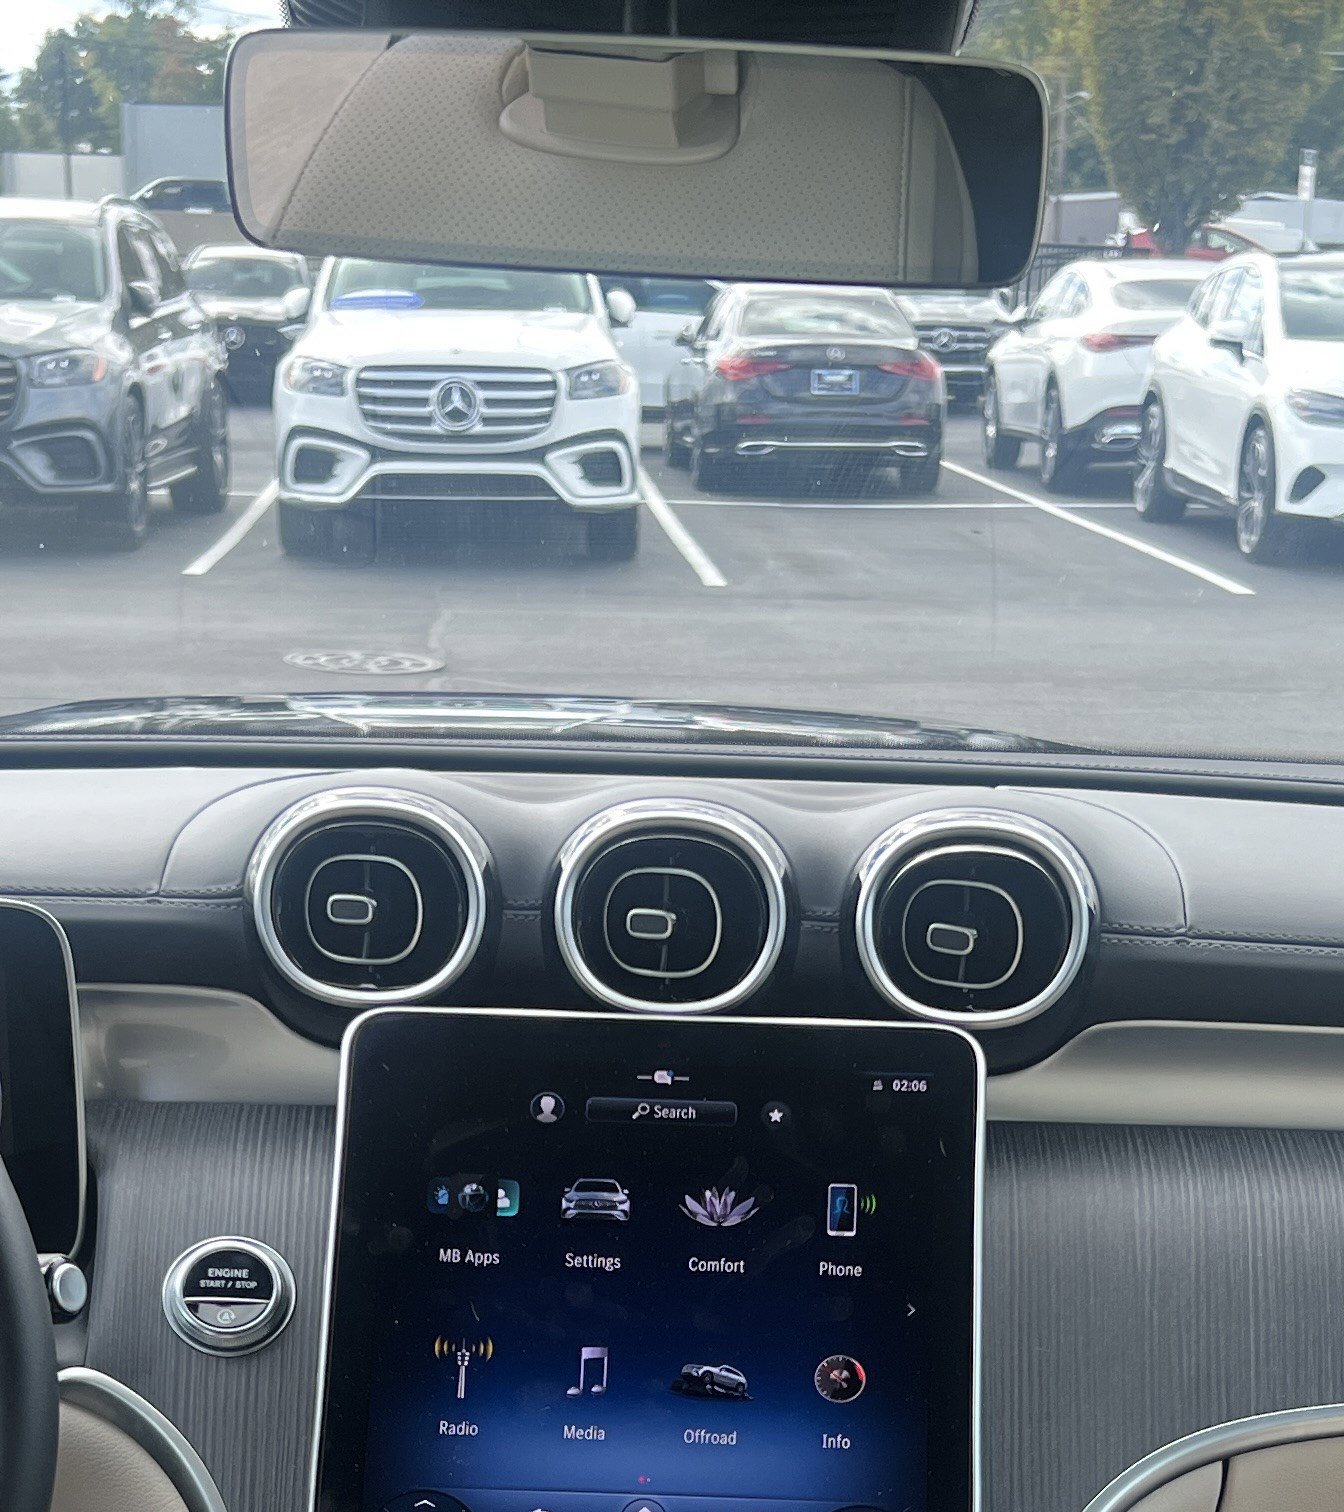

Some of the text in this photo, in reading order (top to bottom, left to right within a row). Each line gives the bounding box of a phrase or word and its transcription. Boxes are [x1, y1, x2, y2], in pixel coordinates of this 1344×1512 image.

[892, 1079, 927, 1092] 02:06
[653, 1104, 696, 1120] Search
[438, 1249, 500, 1266] MB Apps
[564, 1252, 621, 1271] Settings
[688, 1256, 745, 1274] Comfort
[208, 1268, 249, 1278] ENGINE
[818, 1261, 863, 1278] Phone
[199, 1280, 225, 1288] START
[234, 1280, 258, 1289] STOP
[438, 1420, 479, 1437] Radio
[563, 1424, 606, 1441] Media
[683, 1428, 737, 1446] Offroad
[821, 1433, 851, 1450] Info
